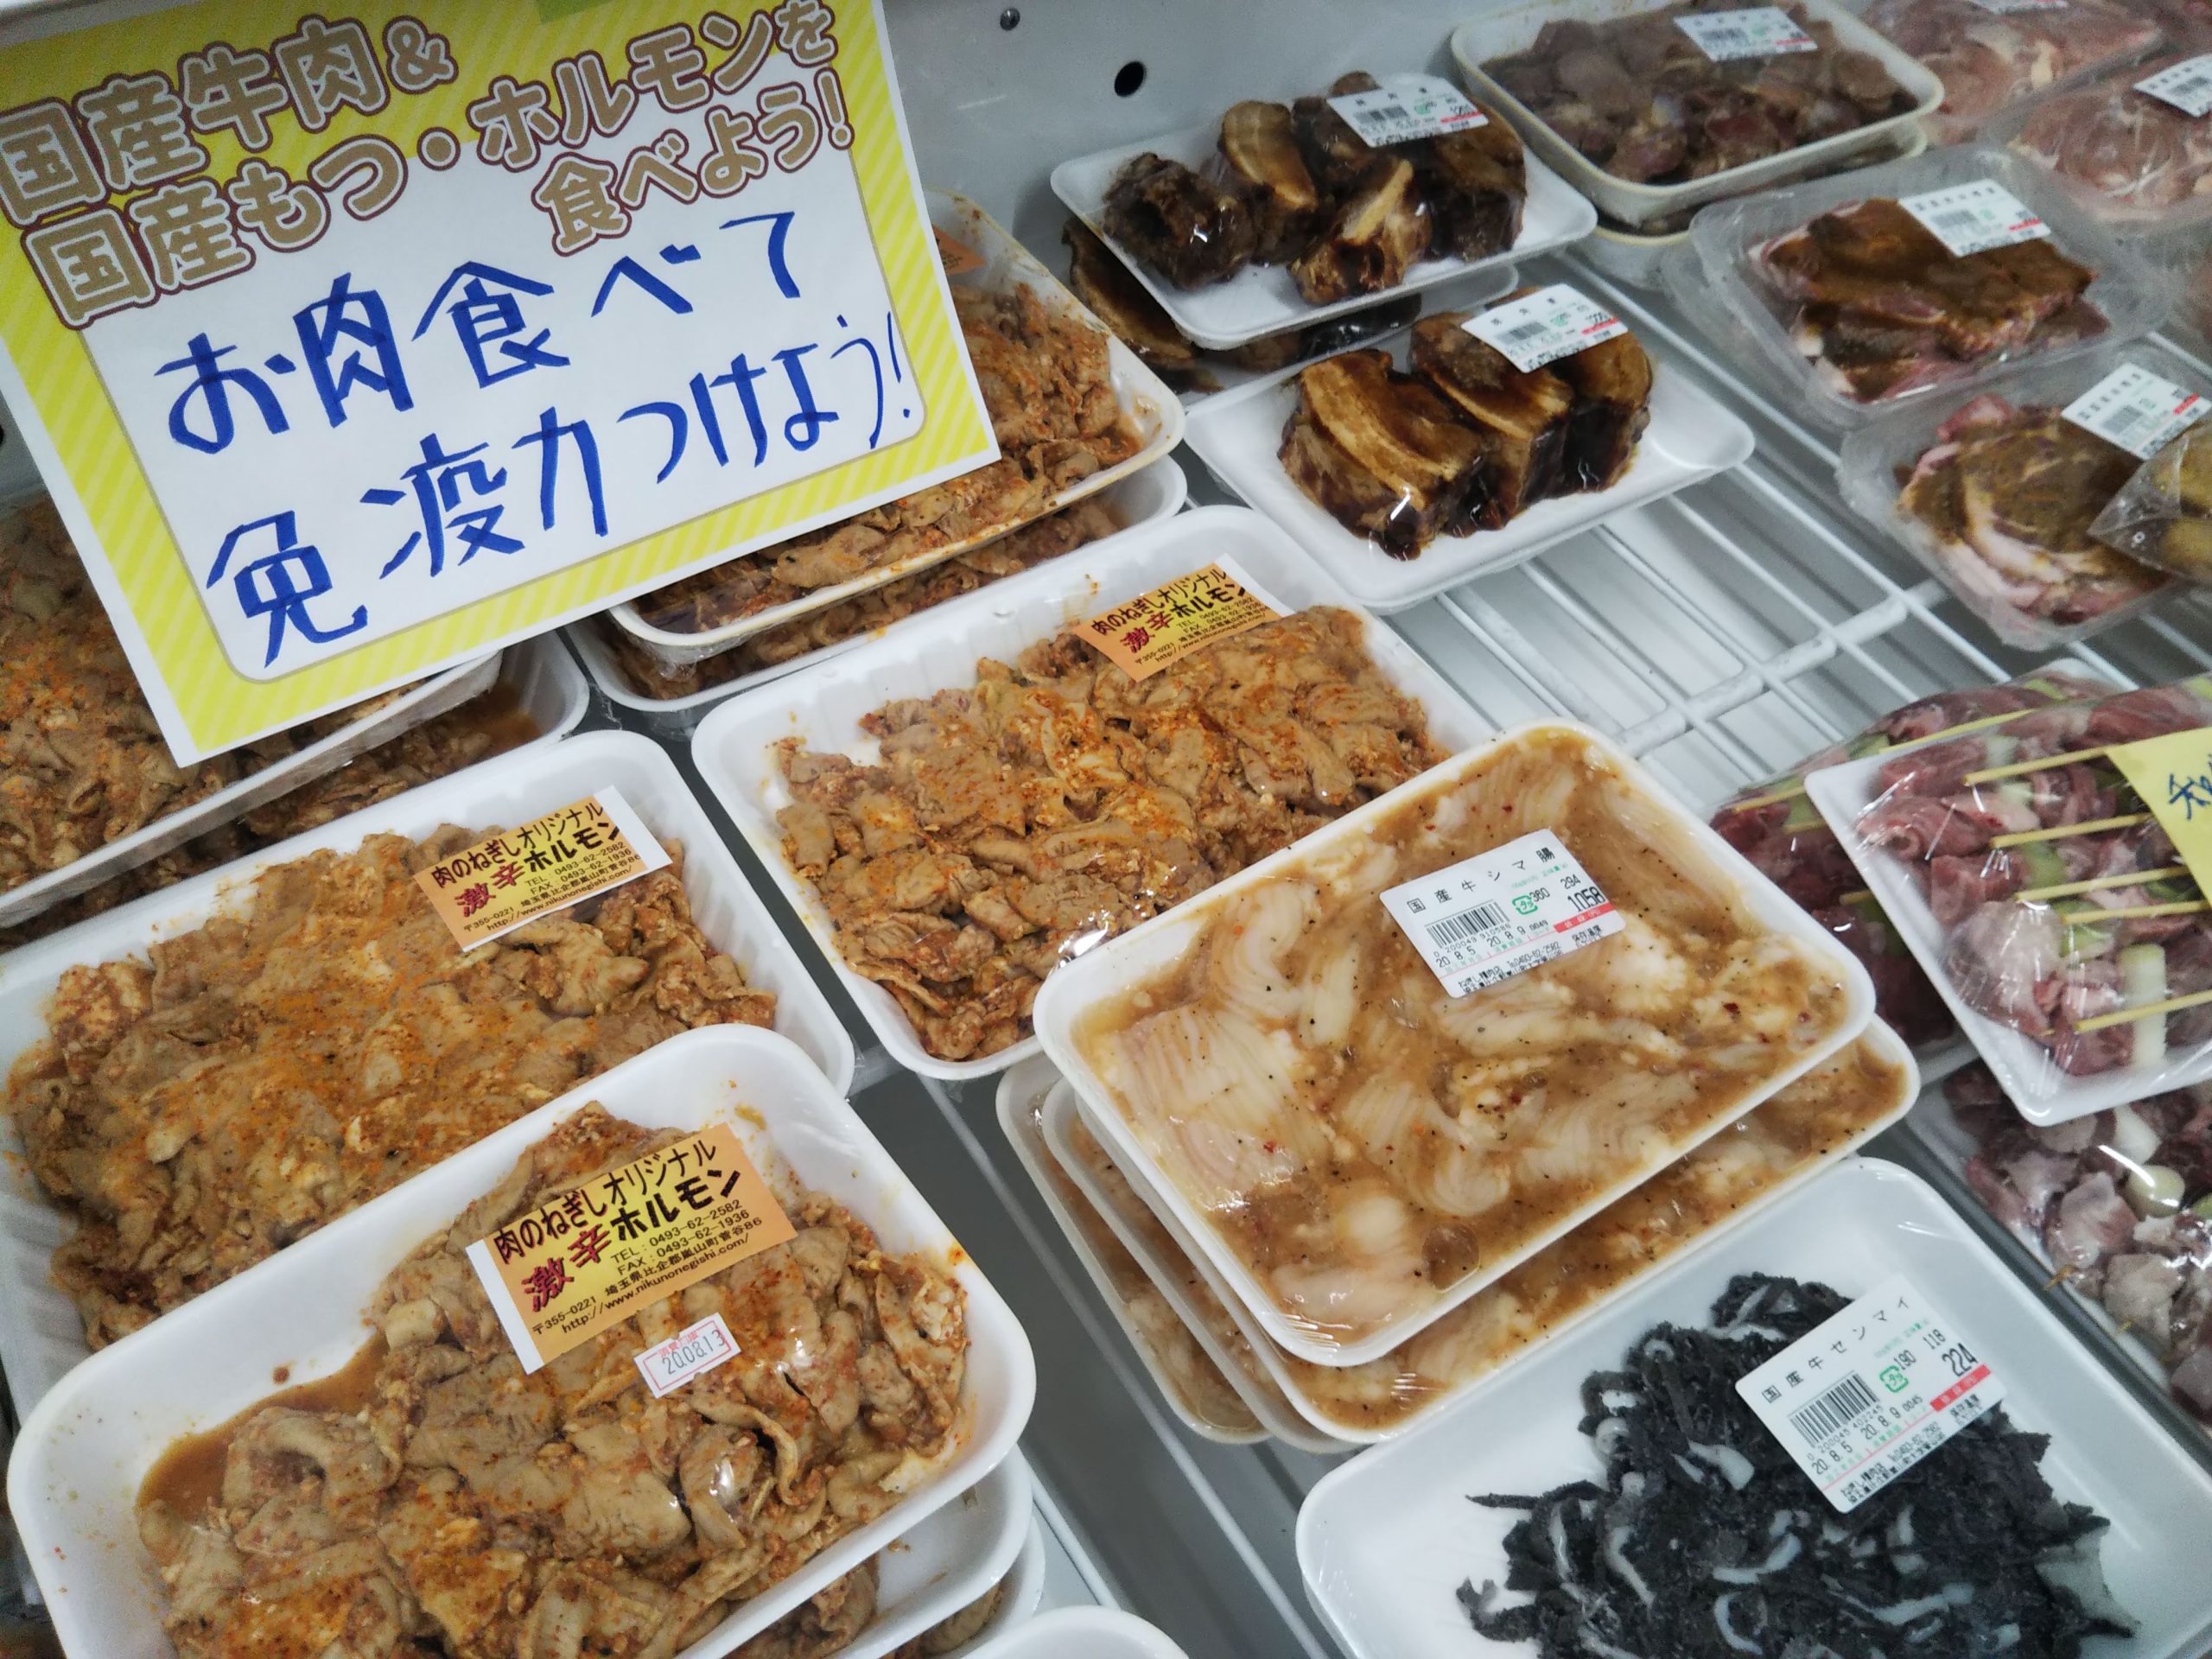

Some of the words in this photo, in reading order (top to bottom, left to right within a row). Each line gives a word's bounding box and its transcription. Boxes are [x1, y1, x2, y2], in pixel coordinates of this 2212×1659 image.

[0, 14, 459, 226] 国産牛肉&
[532, 68, 853, 257] 食べよう!
[156, 211, 800, 454] お肉食べて
[205, 309, 912, 668] 免疫力つけよう!
[1090, 567, 1224, 637] 肉のねぎしオリジナル
[1119, 582, 1243, 653] 激辛ホルモン
[430, 801, 603, 888] 肉のねぎしオリジナル
[453, 823, 618, 918] 激辛ホルモン
[1560, 873, 1580, 889] 294
[1567, 884, 1605, 913] 1058
[491, 1139, 716, 1264] 肉のねぎしオリジナル
[649, 1198, 742, 1249] 0493-62-2582
[655, 1207, 750, 1258] 0493-62-1936
[520, 1171, 740, 1313] 激辛ホルモン
[531, 1295, 597, 1336] 〒355-0221
[561, 1232, 749, 1333] http://www.nikunonegishi.com/
[1922, 1327, 1947, 1351] 118
[1940, 1339, 1980, 1379] 224
